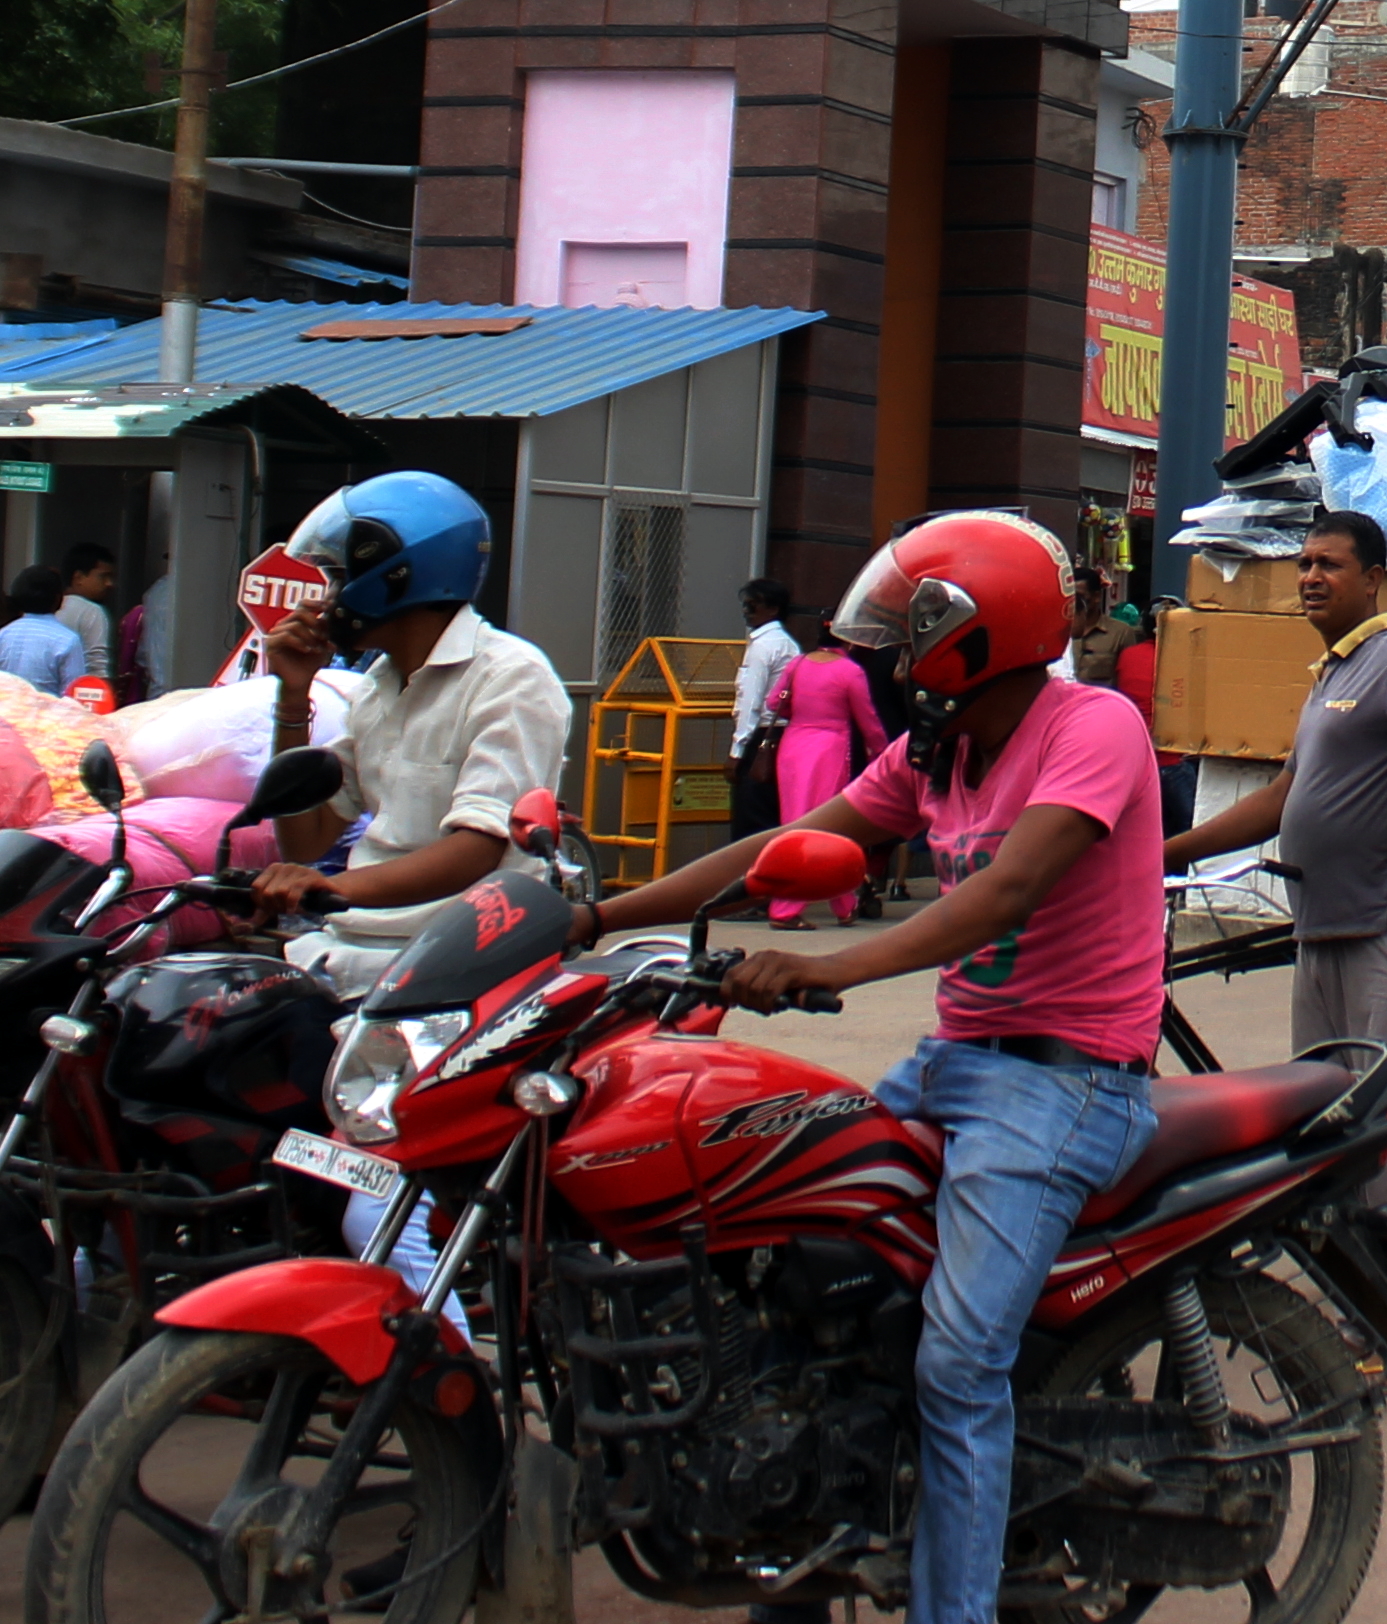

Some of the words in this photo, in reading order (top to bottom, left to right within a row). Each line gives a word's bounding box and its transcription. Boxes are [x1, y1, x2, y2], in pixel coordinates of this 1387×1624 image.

[243, 573, 325, 611] STOP
[351, 1159, 394, 1195] 9437
[1070, 1275, 1104, 1304] Hero
